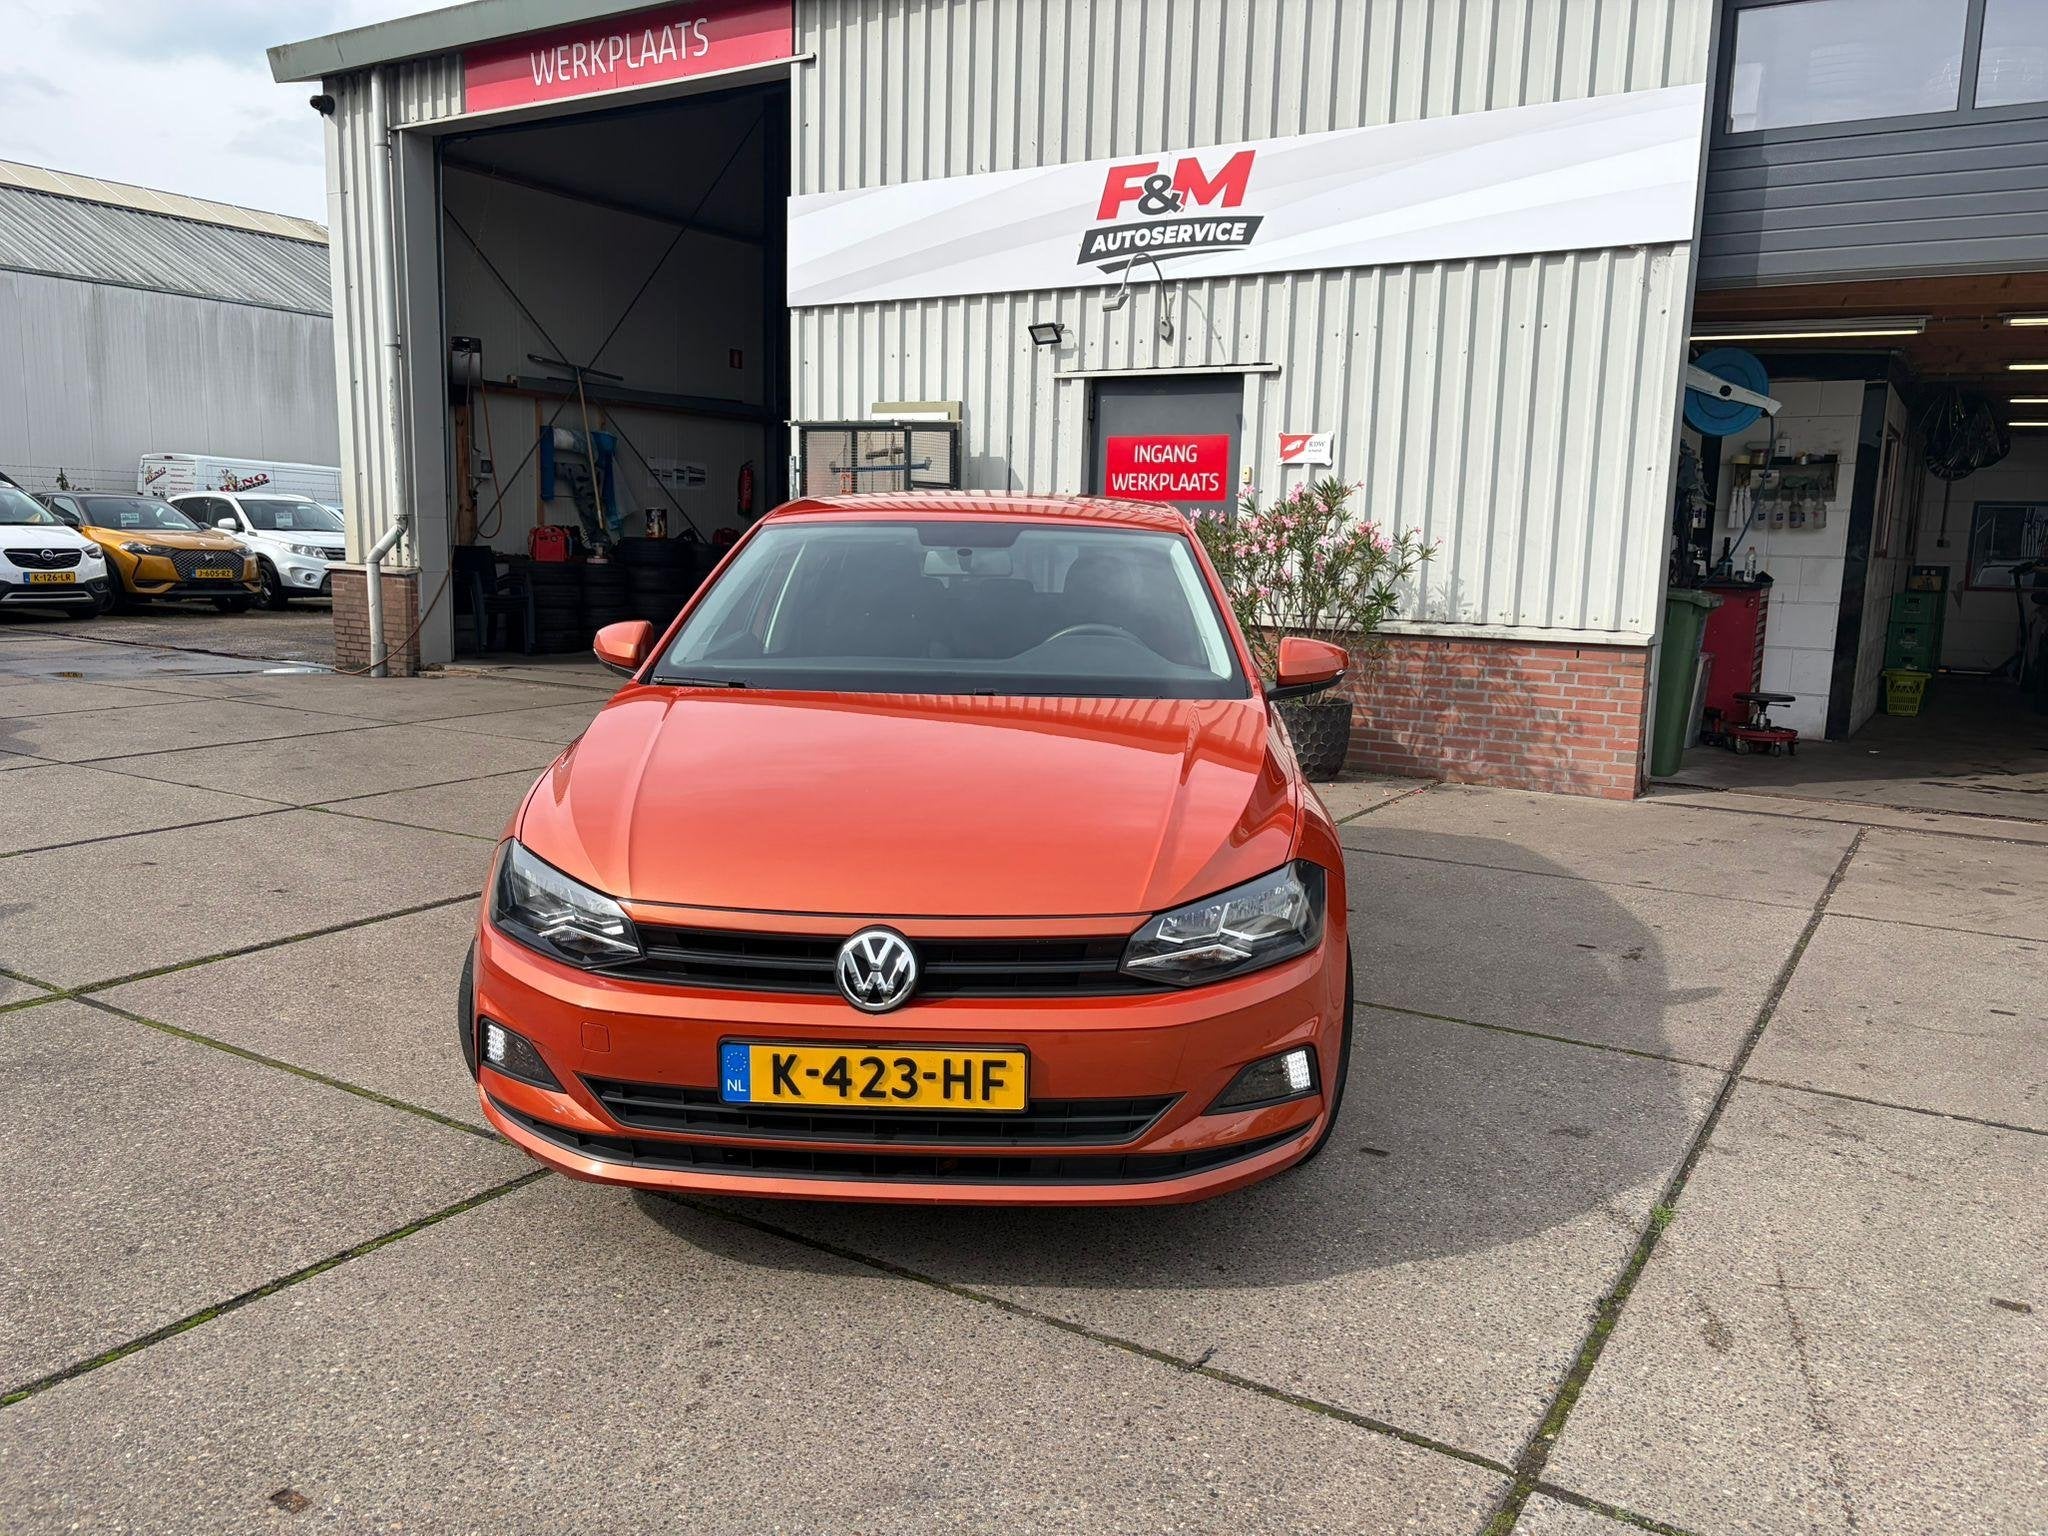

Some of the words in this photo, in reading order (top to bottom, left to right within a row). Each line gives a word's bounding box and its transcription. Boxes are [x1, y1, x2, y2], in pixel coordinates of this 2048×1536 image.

[530, 18, 709, 86] WERKPLAATS
[1096, 149, 1256, 221] F&M
[1090, 222, 1248, 255] AUTOSERVICE
[1134, 444, 1198, 463] INGANG
[1112, 472, 1220, 493] WERKPLAATS
[34, 574, 71, 582] K-126-LR
[727, 1078, 747, 1093] NL
[771, 1053, 1007, 1101] K-423-HF
